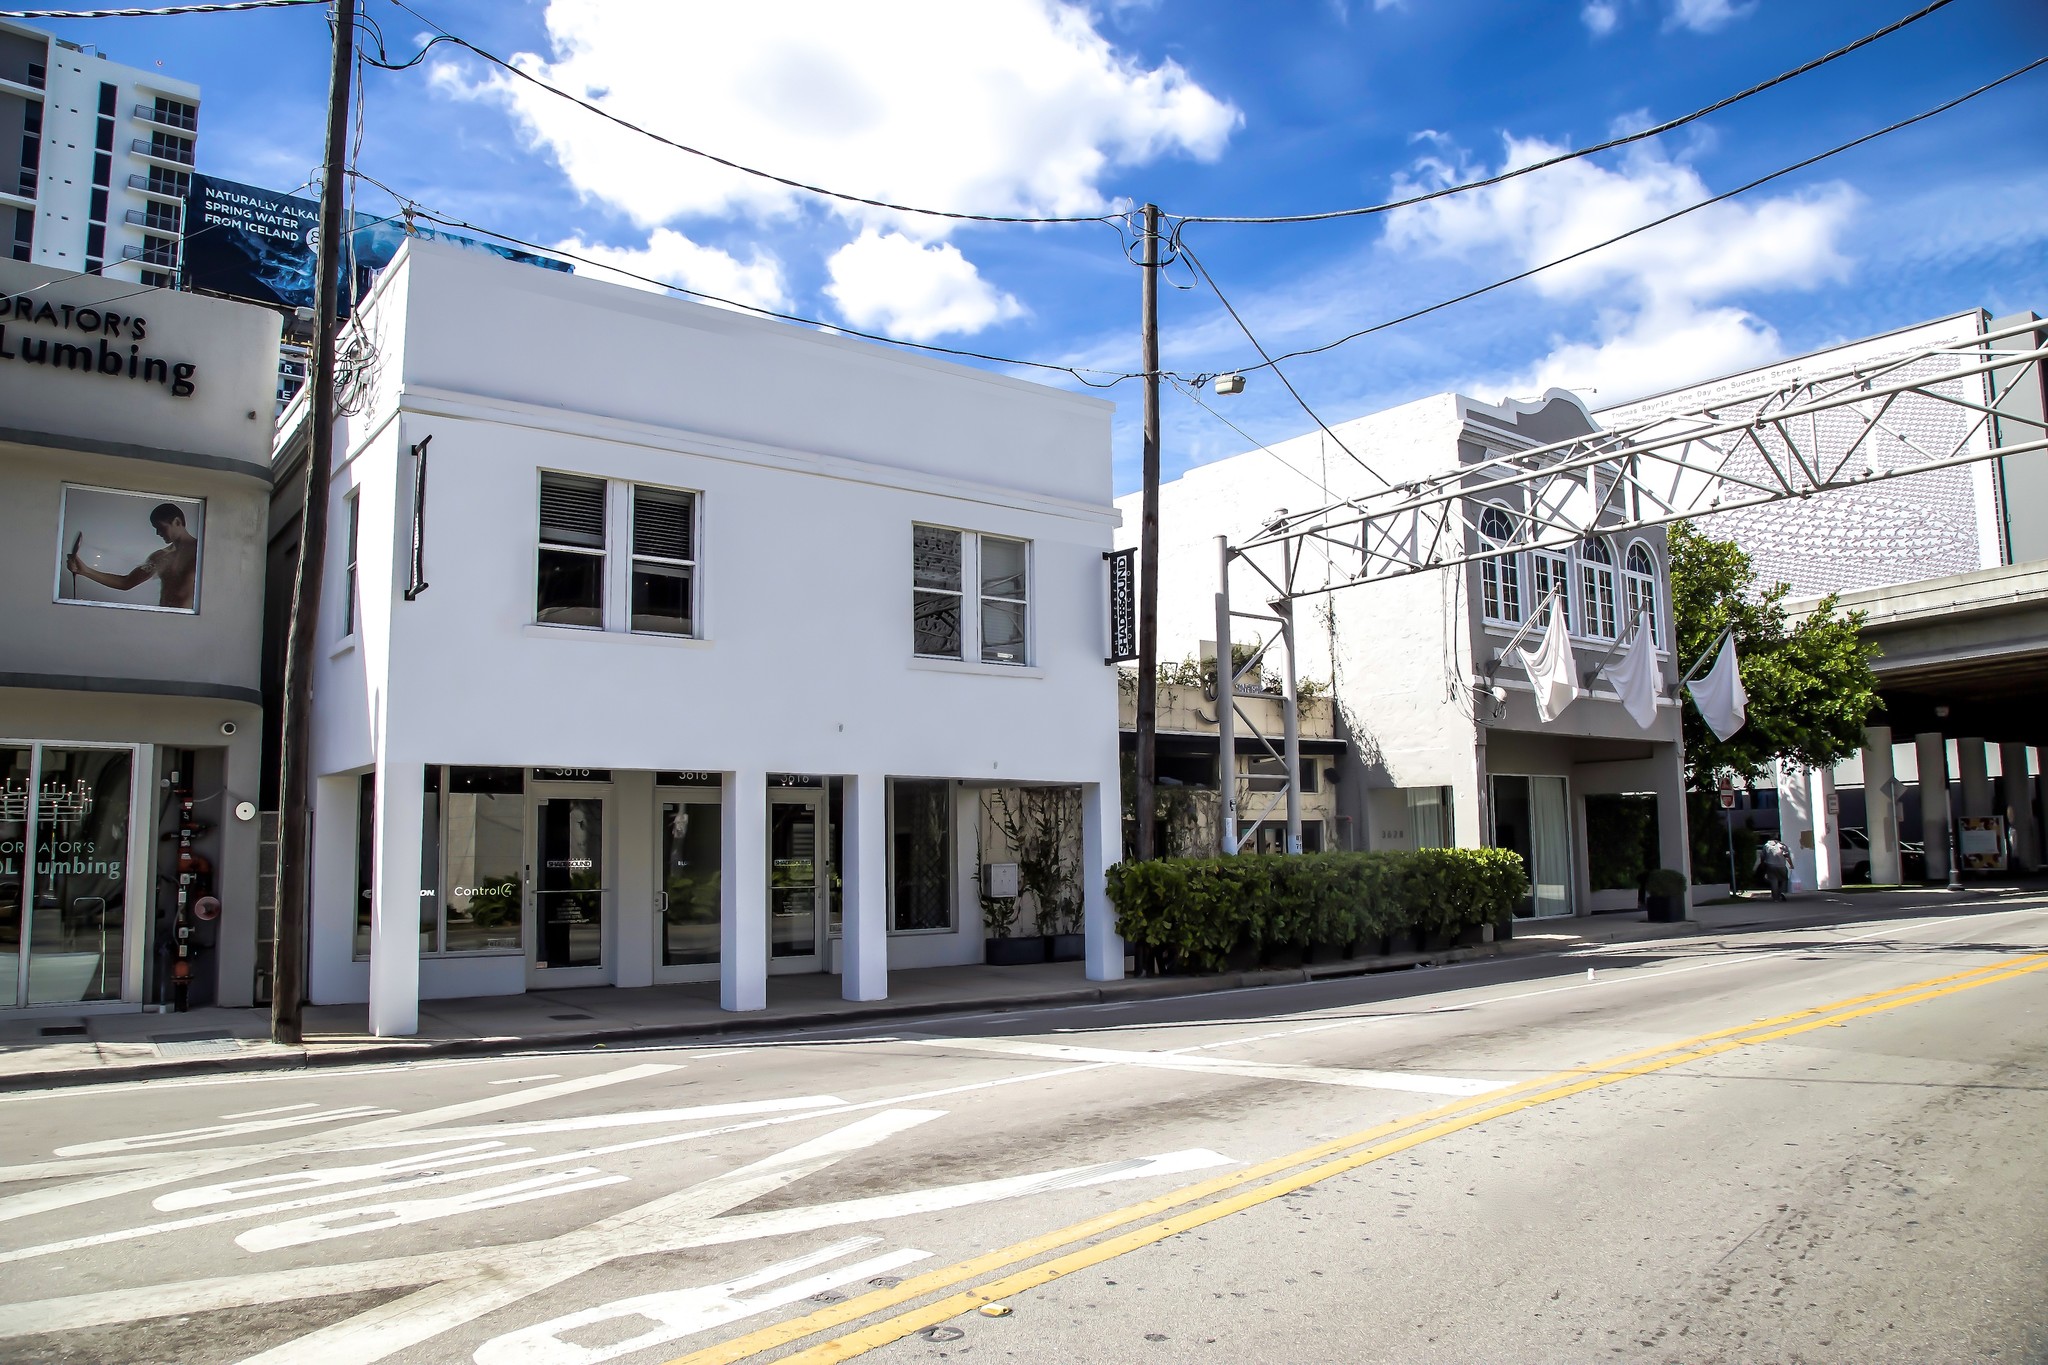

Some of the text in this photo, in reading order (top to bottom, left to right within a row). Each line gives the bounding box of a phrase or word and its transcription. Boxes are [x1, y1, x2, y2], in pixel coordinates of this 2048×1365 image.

[205, 187, 279, 212] NATURALLY
[204, 213, 299, 241] FROM ICELAND
[205, 200, 299, 229] SPRING WATER
[1611, 408, 1638, 419] Thomas
[1678, 394, 1693, 403] One
[1697, 389, 1712, 397] Day
[1730, 375, 1766, 389] Success
[1770, 366, 1802, 378] Street
